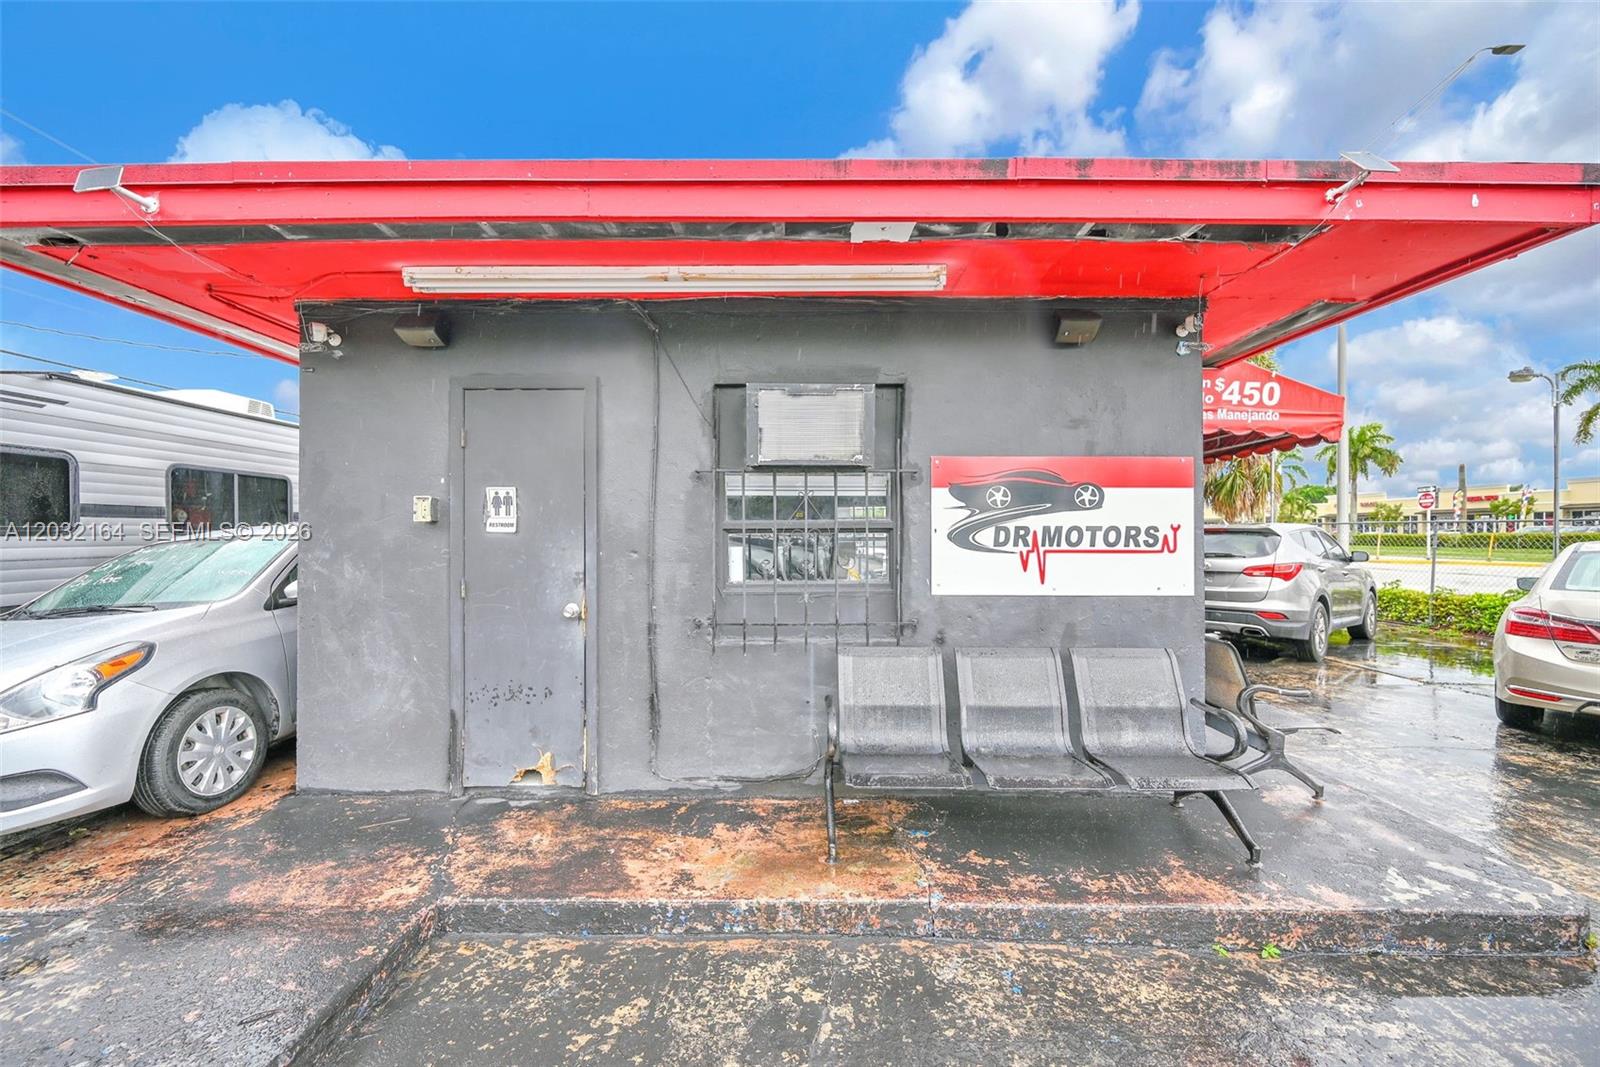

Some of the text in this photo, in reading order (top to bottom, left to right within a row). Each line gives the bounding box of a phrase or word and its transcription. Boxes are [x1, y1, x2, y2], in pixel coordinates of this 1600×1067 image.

[1215, 377, 1281, 407] $450
[1218, 408, 1280, 423] Manejando
[993, 525, 1160, 548] DR MOTORS
